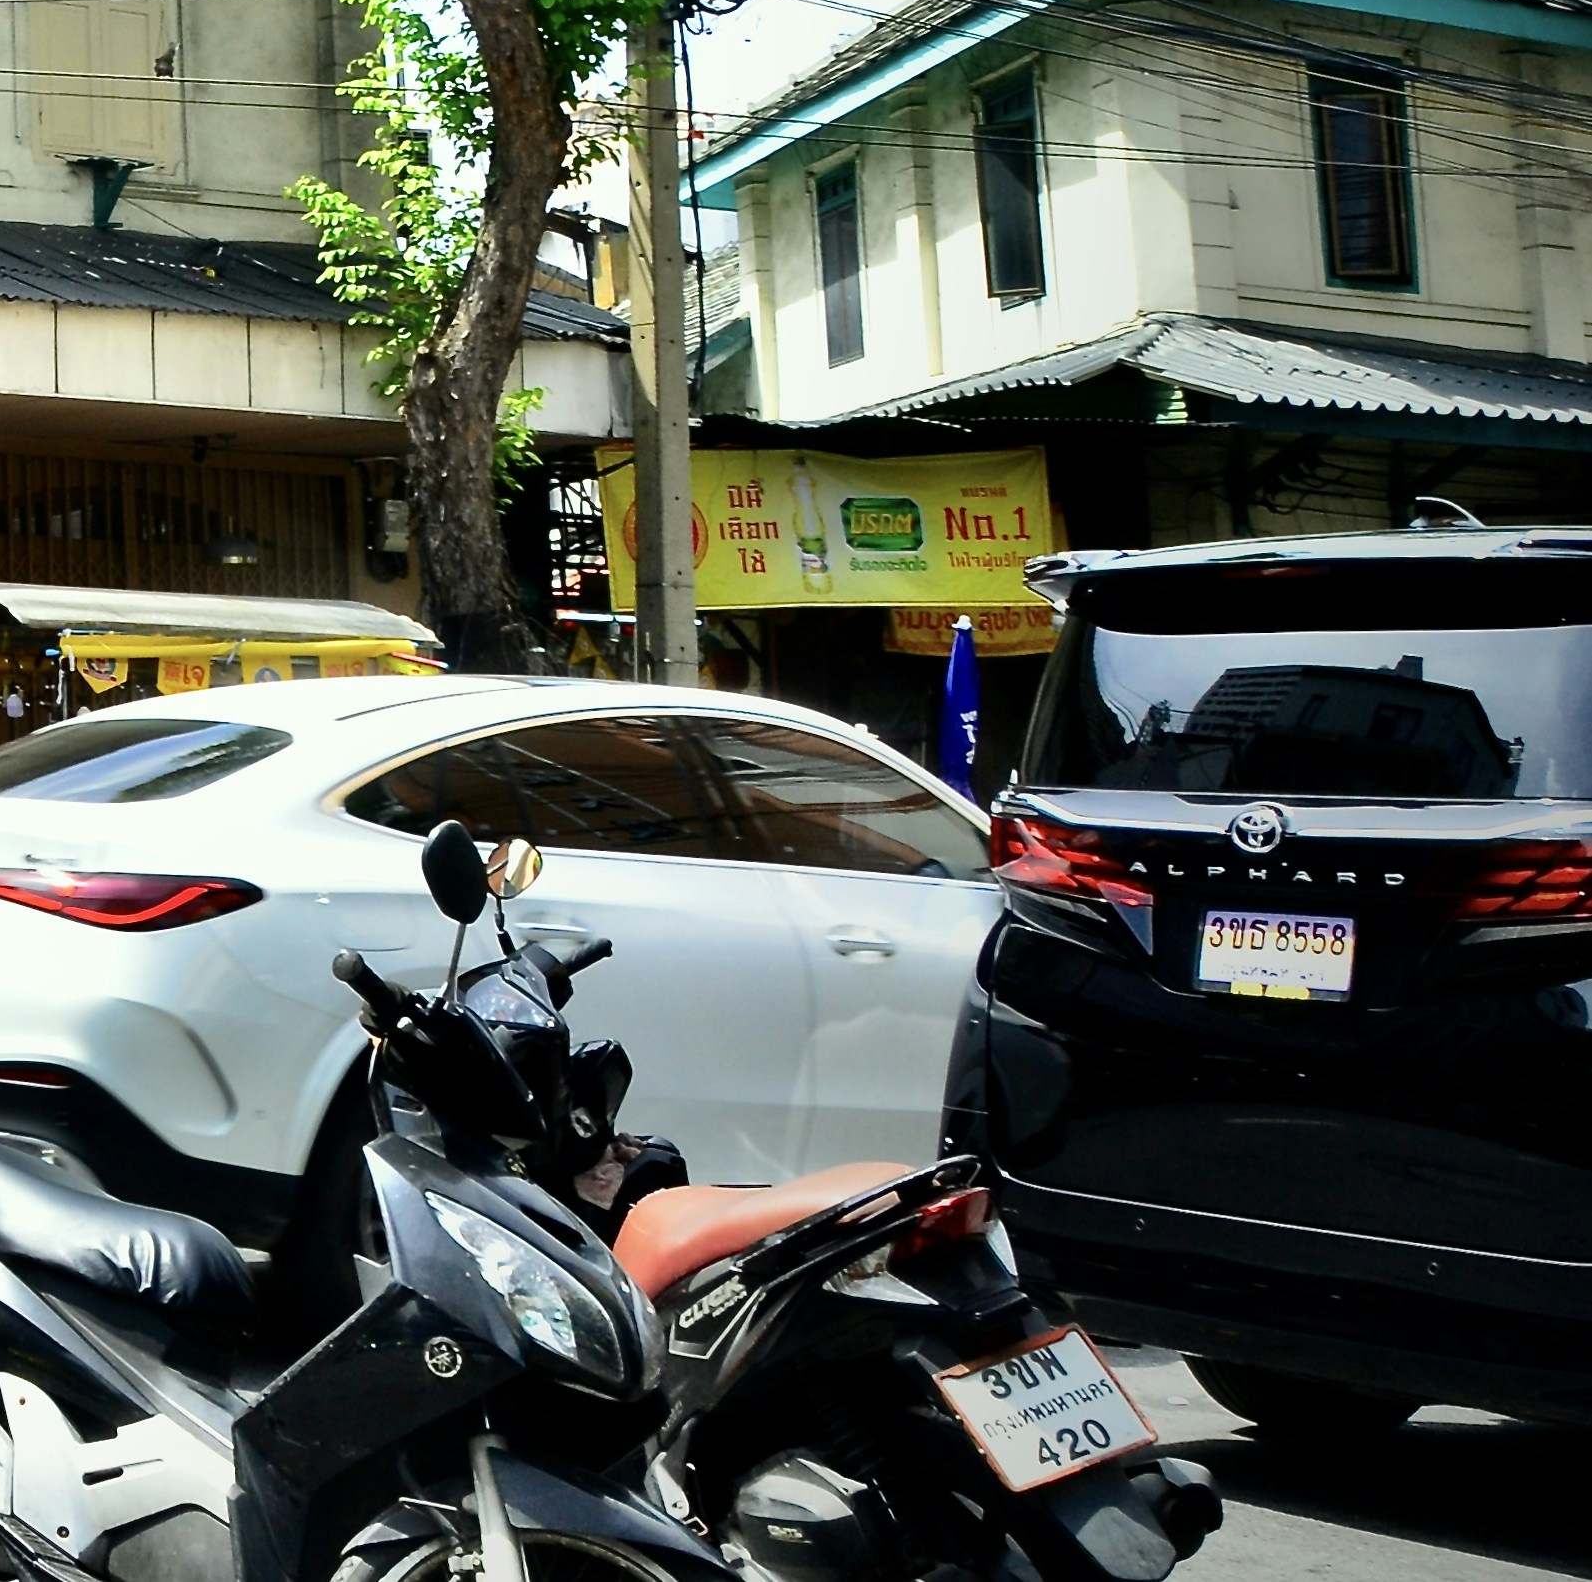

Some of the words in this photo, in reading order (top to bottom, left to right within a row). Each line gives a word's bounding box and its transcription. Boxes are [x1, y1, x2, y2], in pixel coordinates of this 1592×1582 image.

[719, 516, 779, 540] เลือก
[944, 506, 1031, 541] No.1
[737, 548, 766, 573] ใช้
[1129, 861, 1406, 886] ALPHARD
[1275, 920, 1347, 956] 8558
[679, 1275, 746, 1329] CLICK
[983, 1379, 1114, 1441] กรุงเทพมหานคร
[1037, 1418, 1112, 1468] 420
